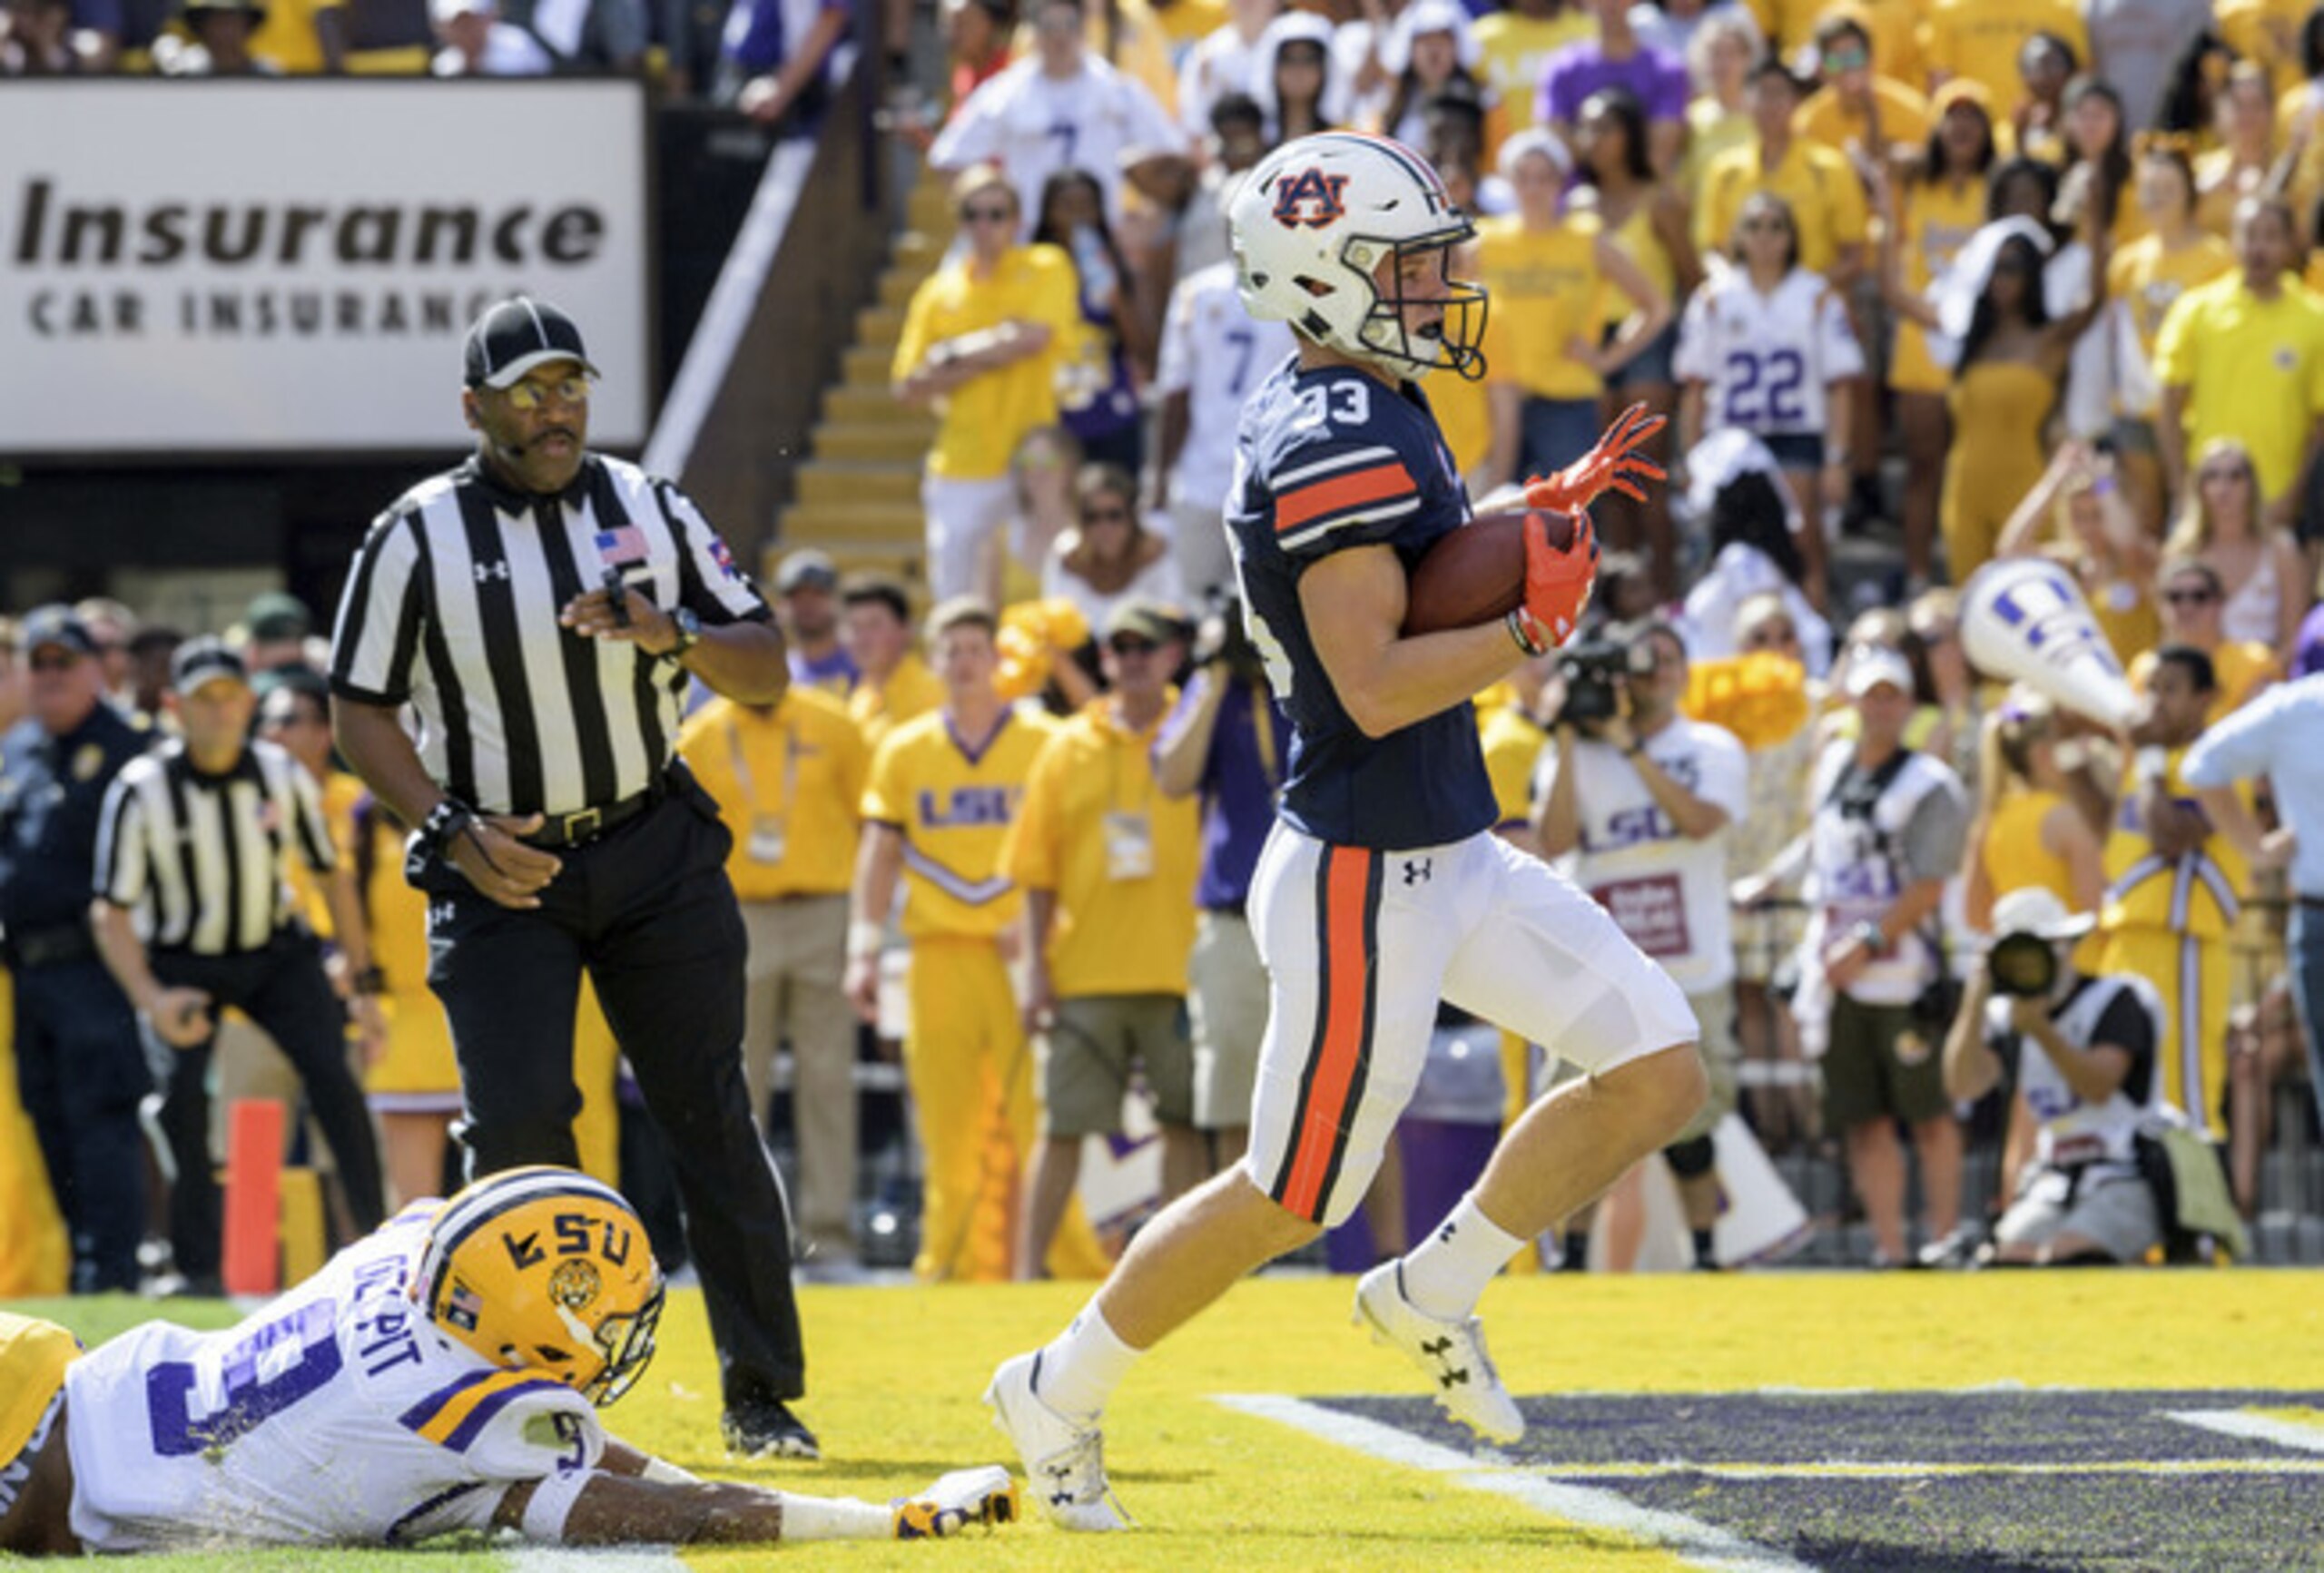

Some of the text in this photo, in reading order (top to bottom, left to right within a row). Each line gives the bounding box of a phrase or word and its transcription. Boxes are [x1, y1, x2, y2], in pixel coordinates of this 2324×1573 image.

[15, 181, 607, 266] Insurance
[28, 288, 143, 337] CAR
[1224, 333, 1259, 398] 7
[1726, 349, 1804, 425] 22
[1293, 379, 1369, 426] 33
[503, 1214, 630, 1271] LSU
